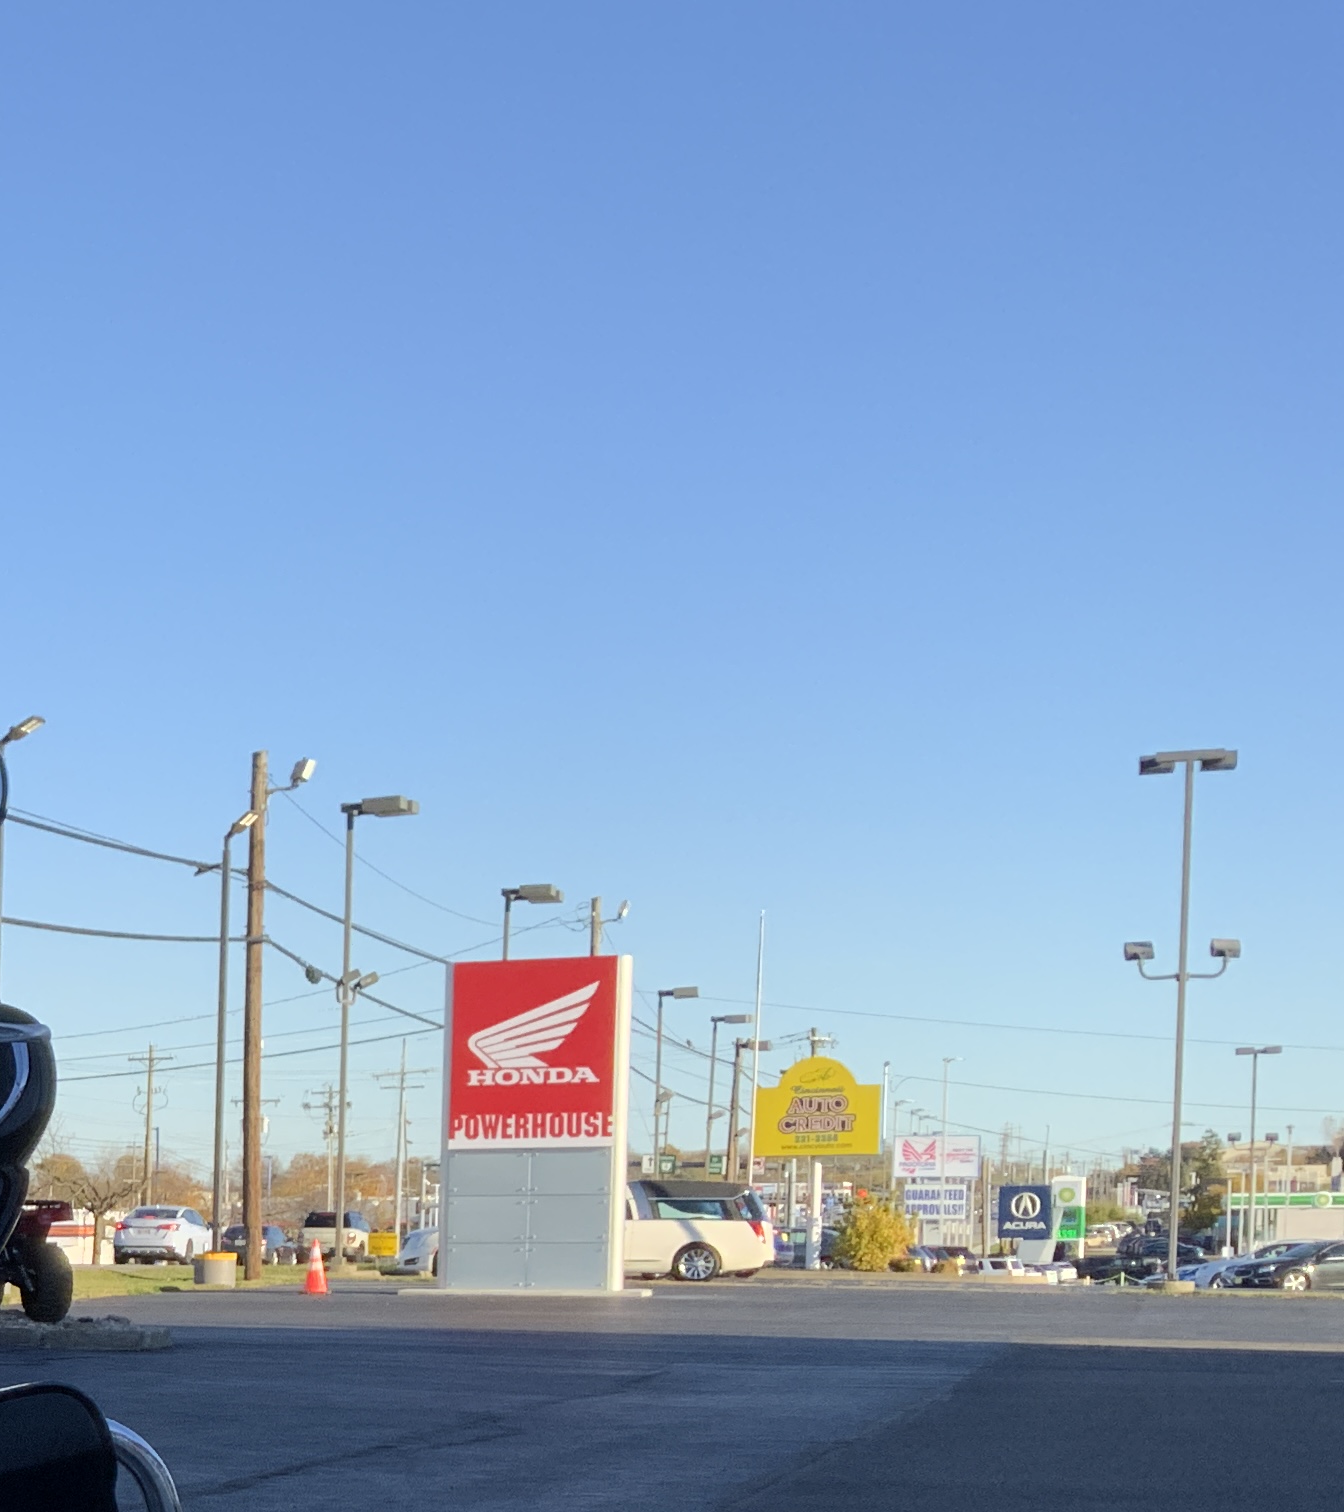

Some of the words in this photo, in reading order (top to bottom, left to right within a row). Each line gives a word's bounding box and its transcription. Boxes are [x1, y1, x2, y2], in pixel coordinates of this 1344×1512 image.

[467, 1067, 600, 1087] HONDA
[786, 1094, 849, 1115] AUTO
[448, 1112, 613, 1141] POWERHOUSE
[778, 1113, 857, 1135] CREDIT
[1003, 1221, 1047, 1230] ACURA
